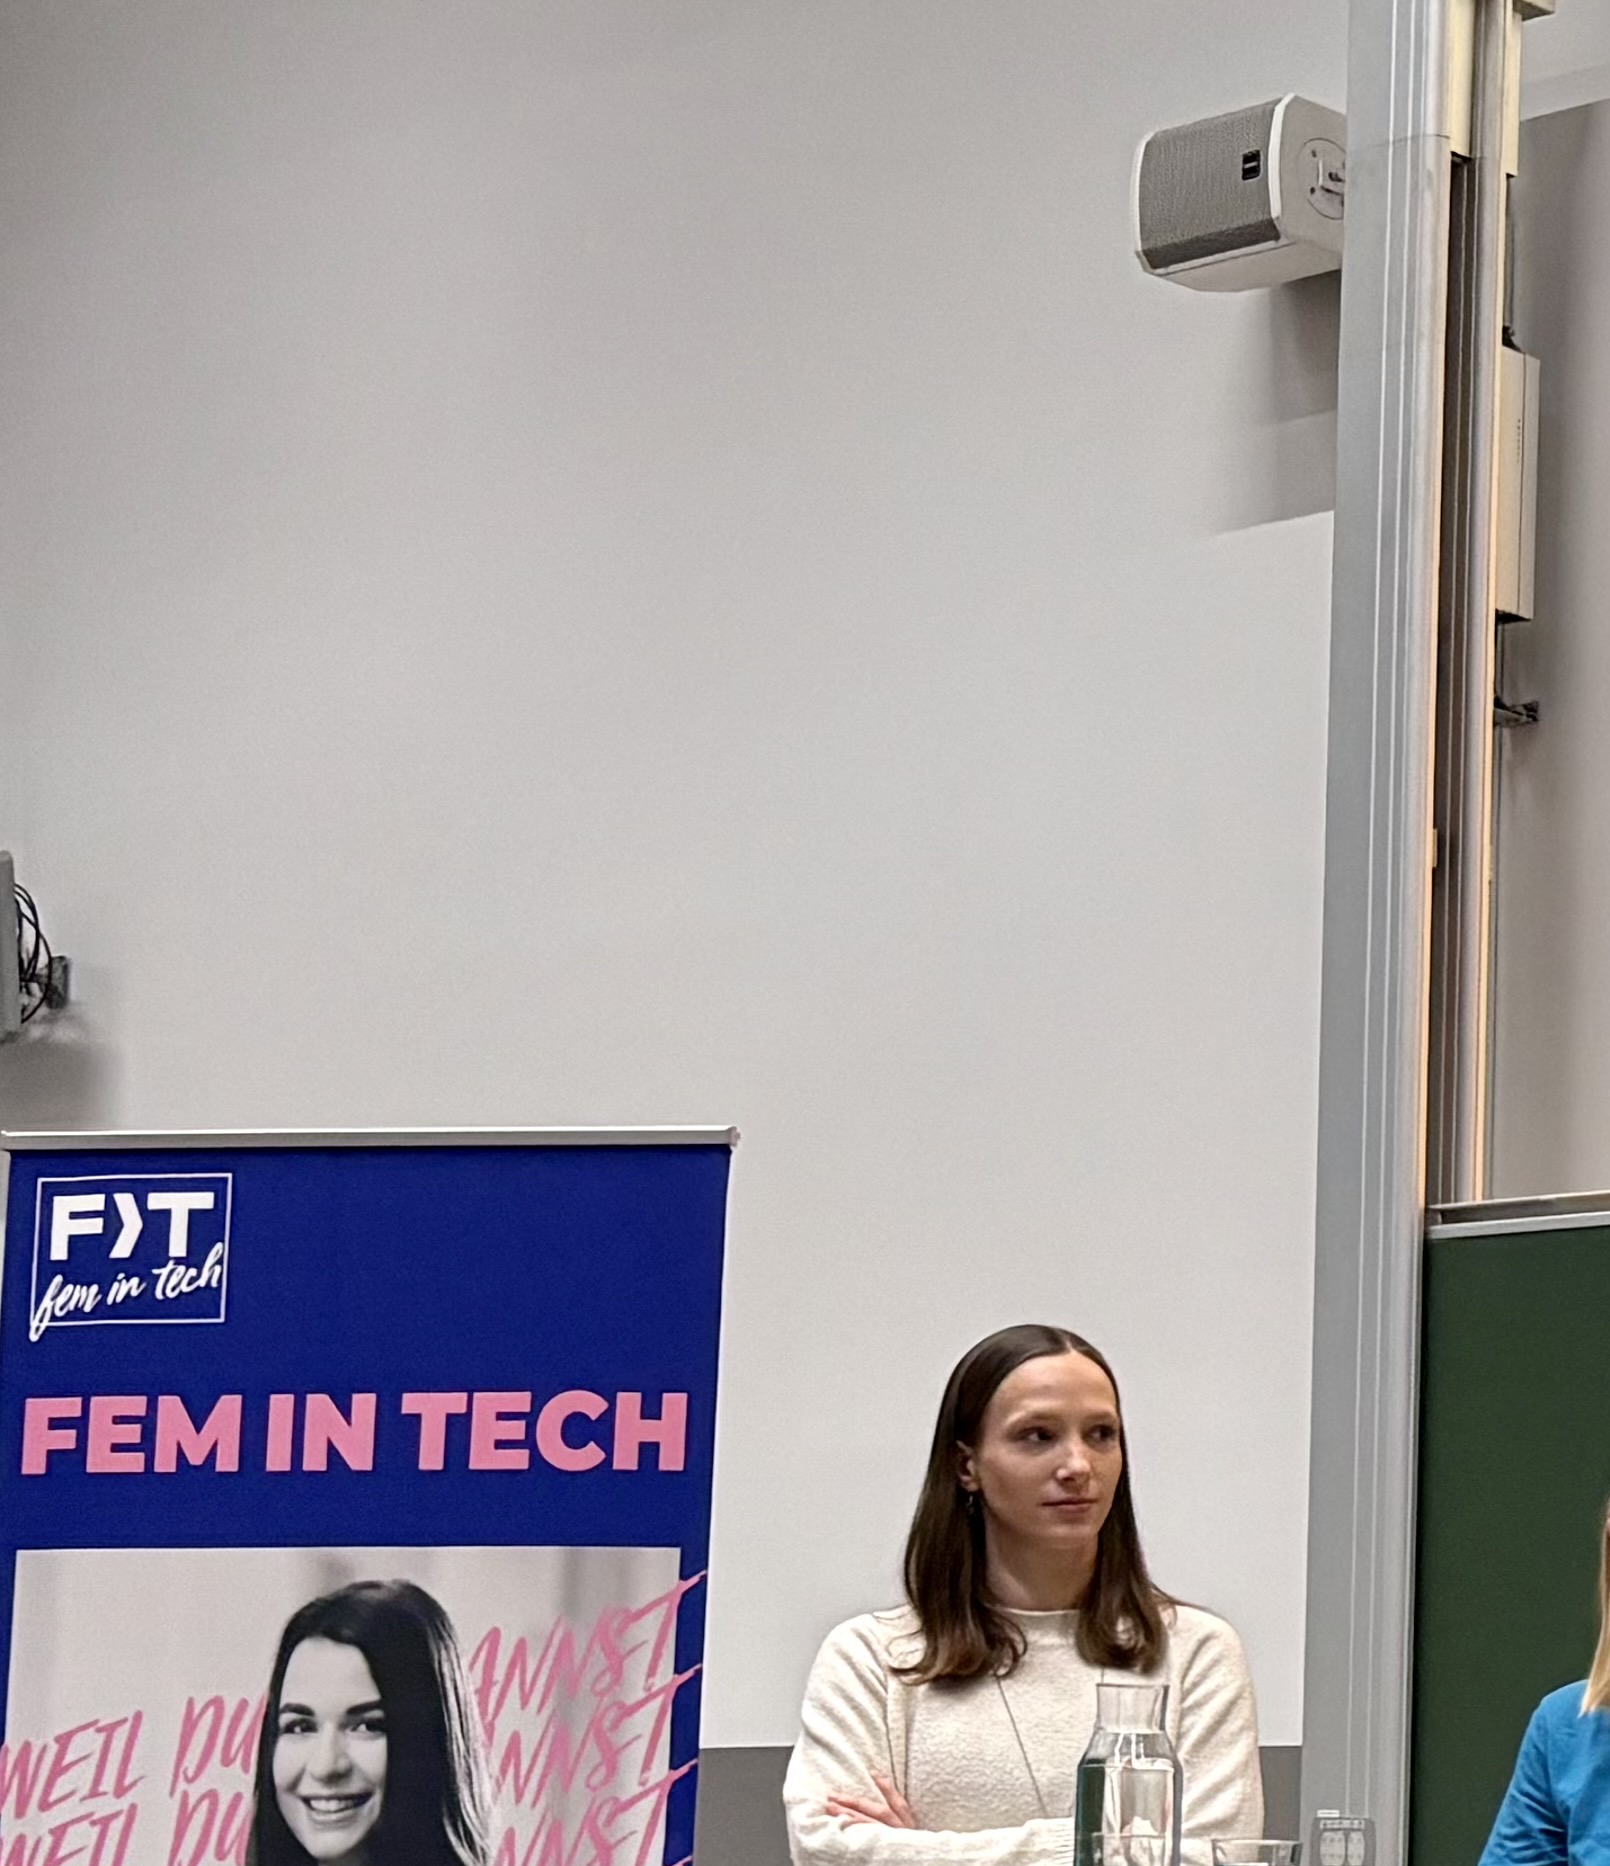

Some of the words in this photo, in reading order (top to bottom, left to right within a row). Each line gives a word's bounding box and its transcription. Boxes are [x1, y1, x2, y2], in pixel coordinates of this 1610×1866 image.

[29, 1274, 102, 1342] fem
[106, 1273, 146, 1306] in
[152, 1241, 225, 1301] tech
[21, 1394, 243, 1476] FEM
[265, 1393, 378, 1472] IN
[401, 1389, 689, 1472] TECH
[169, 1694, 268, 1798] DU
